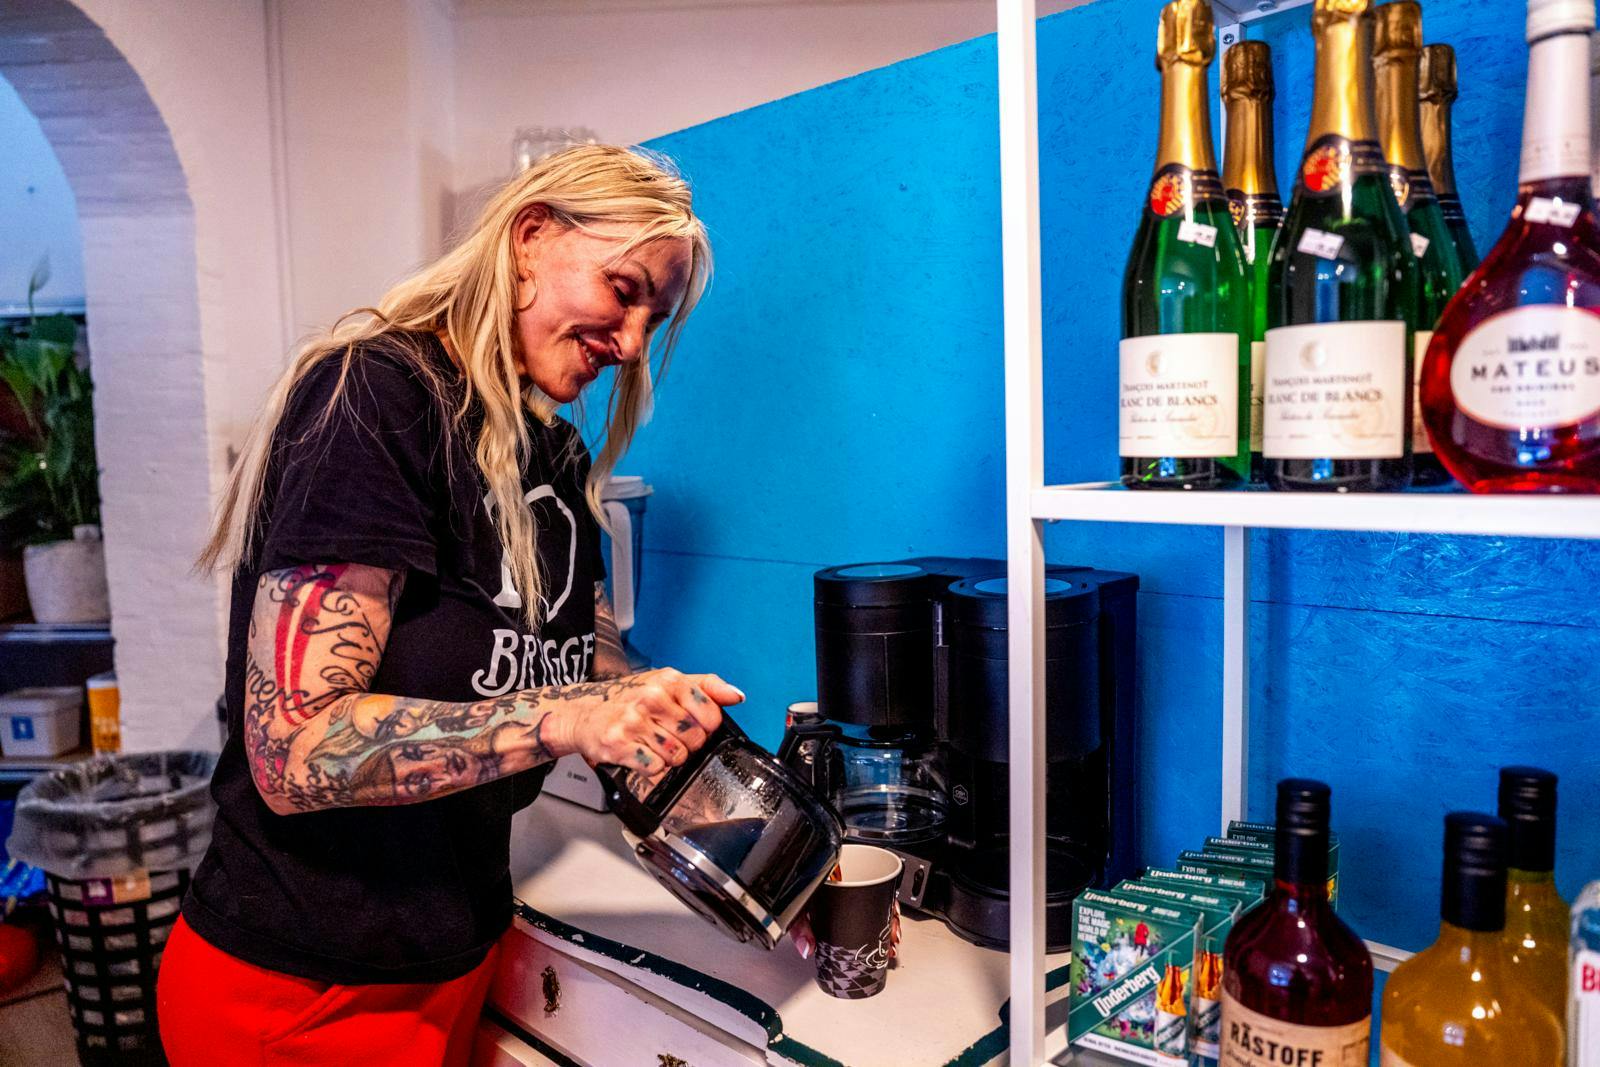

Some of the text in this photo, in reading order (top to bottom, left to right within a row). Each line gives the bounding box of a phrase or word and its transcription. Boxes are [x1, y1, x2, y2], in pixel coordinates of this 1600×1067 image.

[1470, 356, 1600, 381] MATEUS
[1173, 394, 1217, 407] BLANCS
[1324, 389, 1382, 402] BLANCS
[1149, 869, 1214, 885] Underberg
[1121, 882, 1187, 901] Underberg
[1083, 891, 1149, 913] Underberg
[1092, 965, 1162, 1018] Underberg
